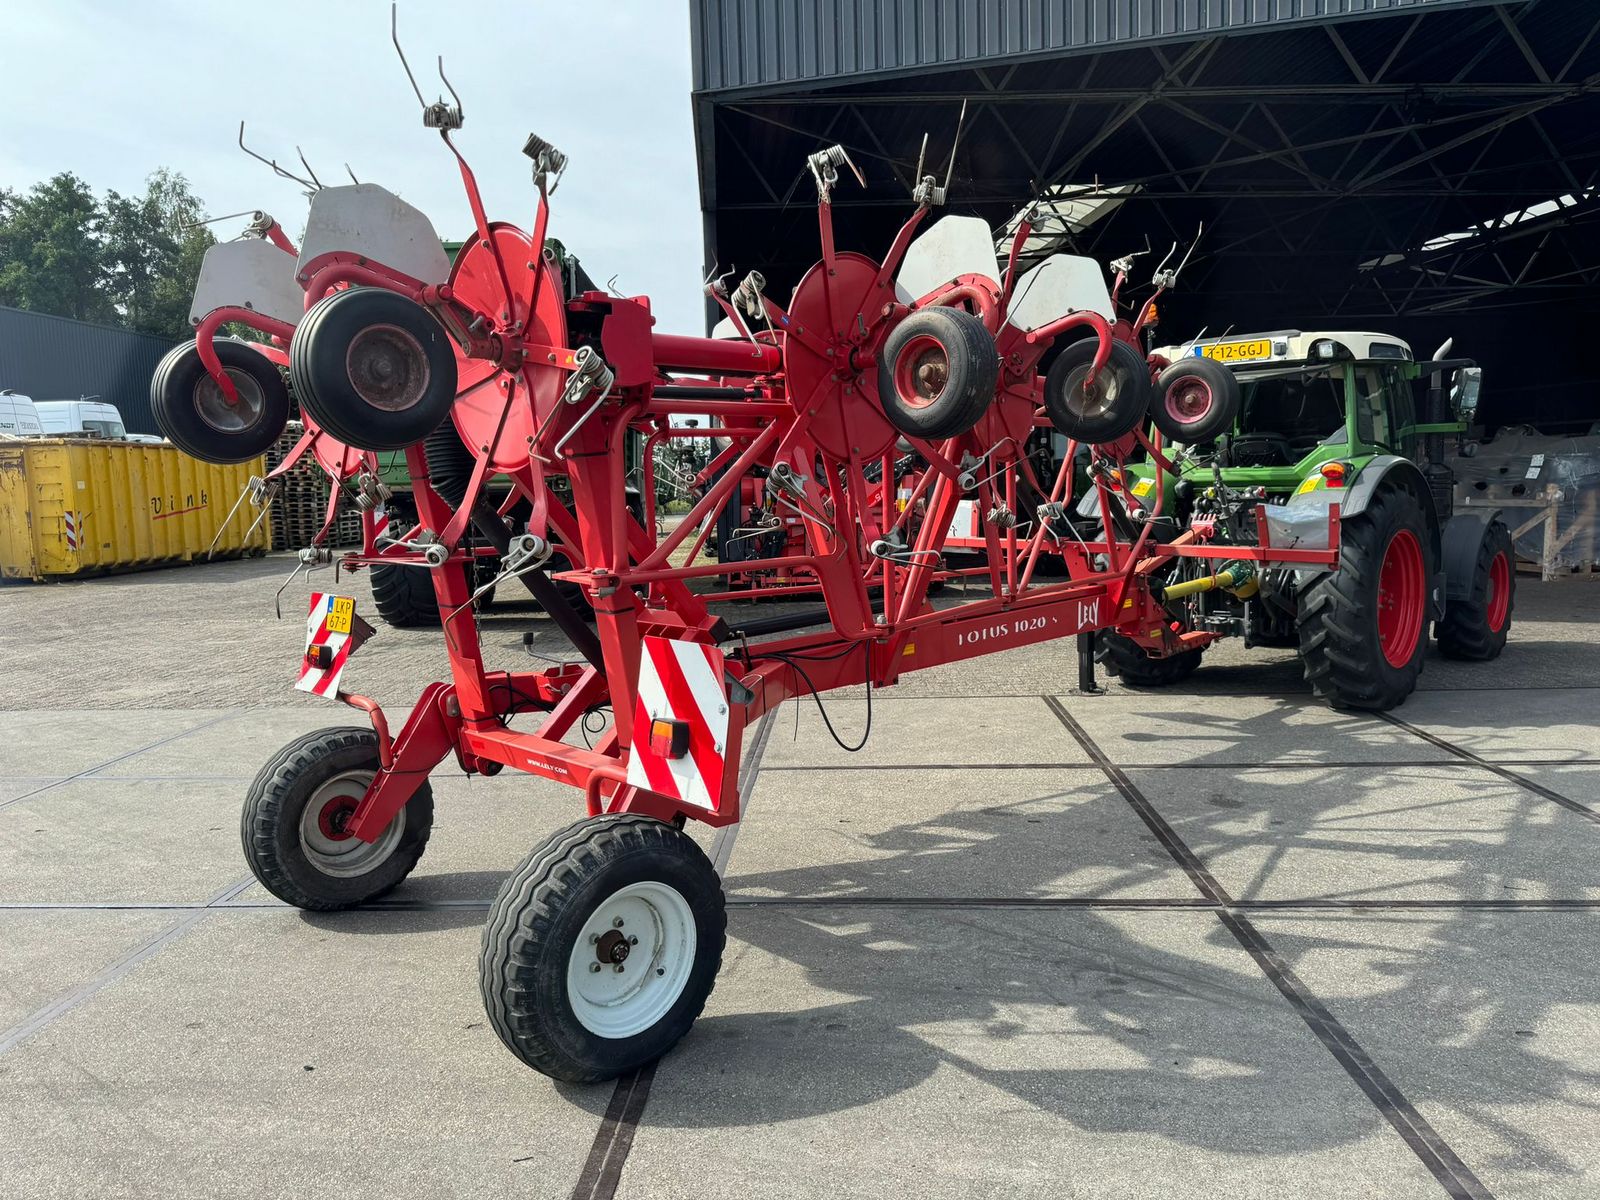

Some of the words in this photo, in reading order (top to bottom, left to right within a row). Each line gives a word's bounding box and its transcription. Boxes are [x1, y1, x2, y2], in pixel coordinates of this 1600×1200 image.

[151, 489, 208, 514] Vink
[335, 600, 351, 614] LKP
[1077, 597, 1099, 630] LELY
[329, 615, 347, 631] 67-P
[1014, 616, 1047, 633] 1020
